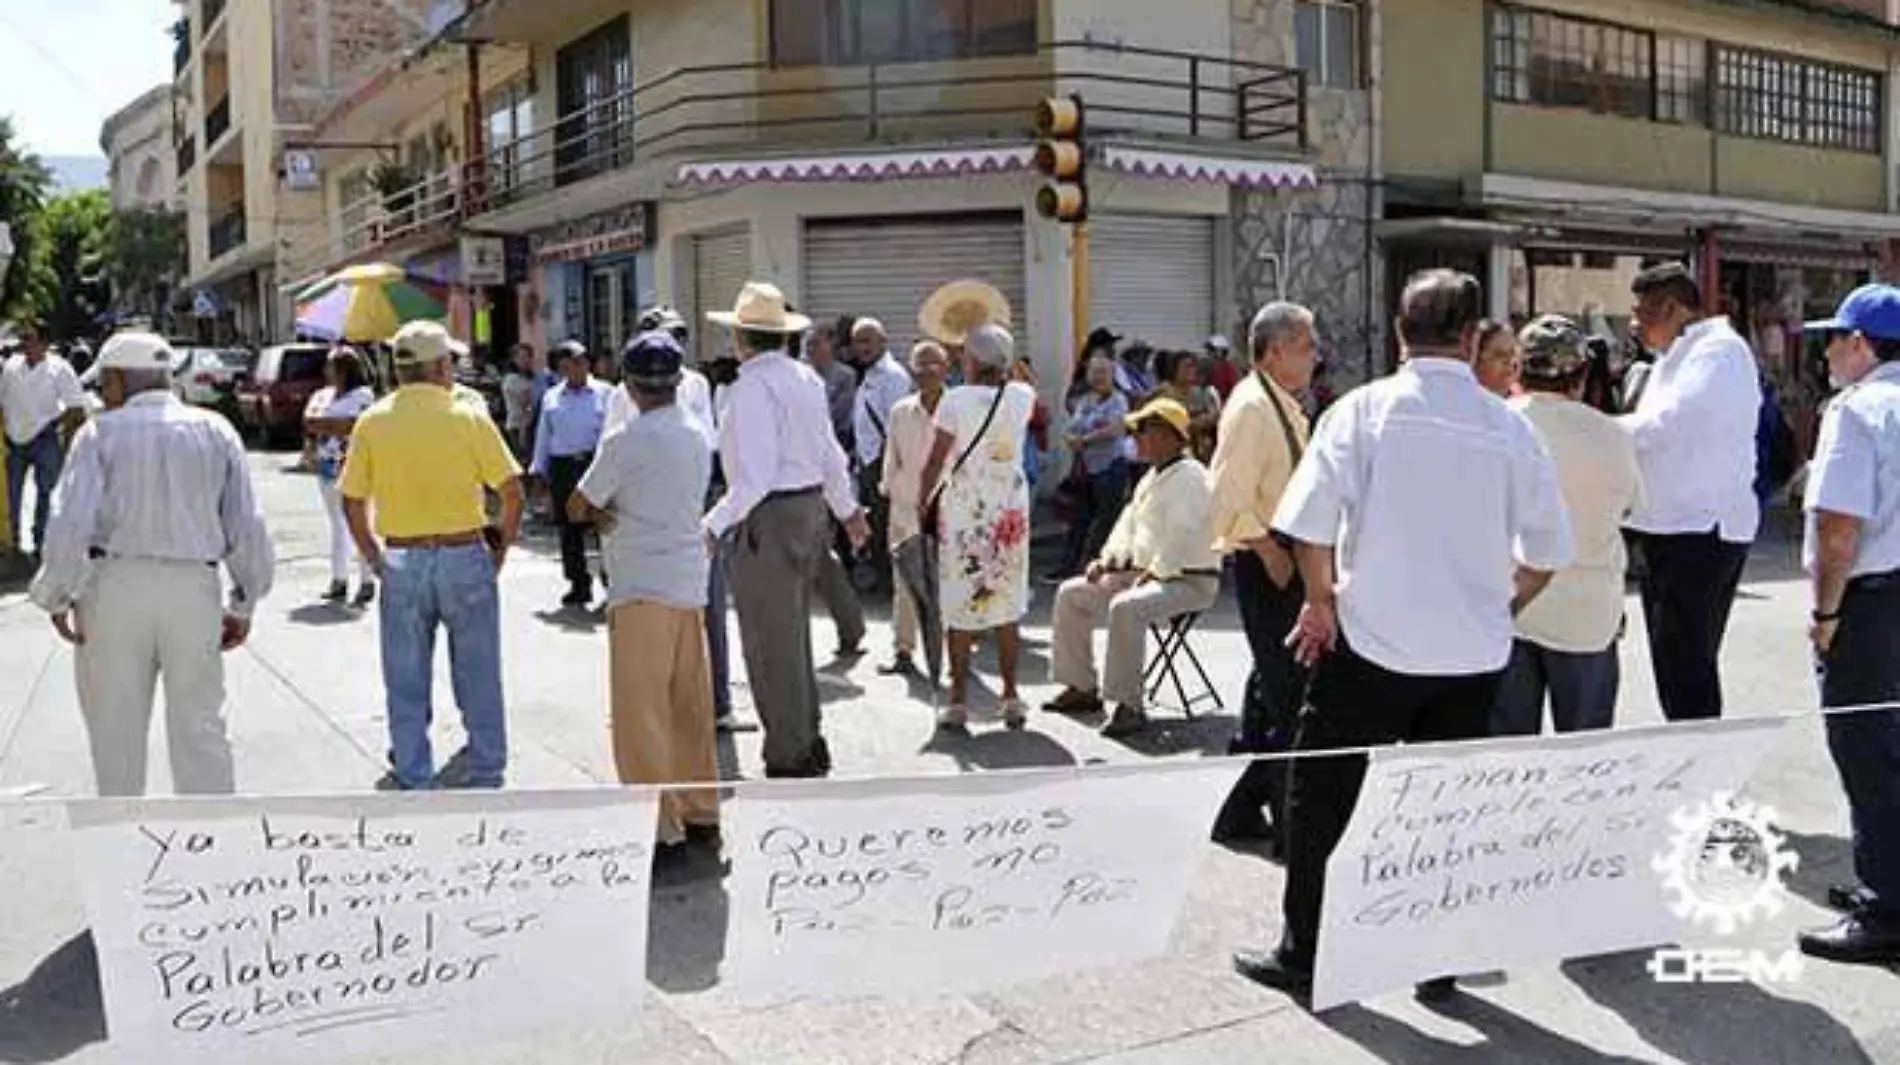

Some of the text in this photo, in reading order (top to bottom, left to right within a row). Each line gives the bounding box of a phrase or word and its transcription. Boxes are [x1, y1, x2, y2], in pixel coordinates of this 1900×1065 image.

[261, 812, 414, 851] basta
[457, 818, 527, 847] de
[759, 808, 1075, 866] Queremos
[765, 861, 932, 910] pagos
[171, 953, 499, 1034] Gobernador
